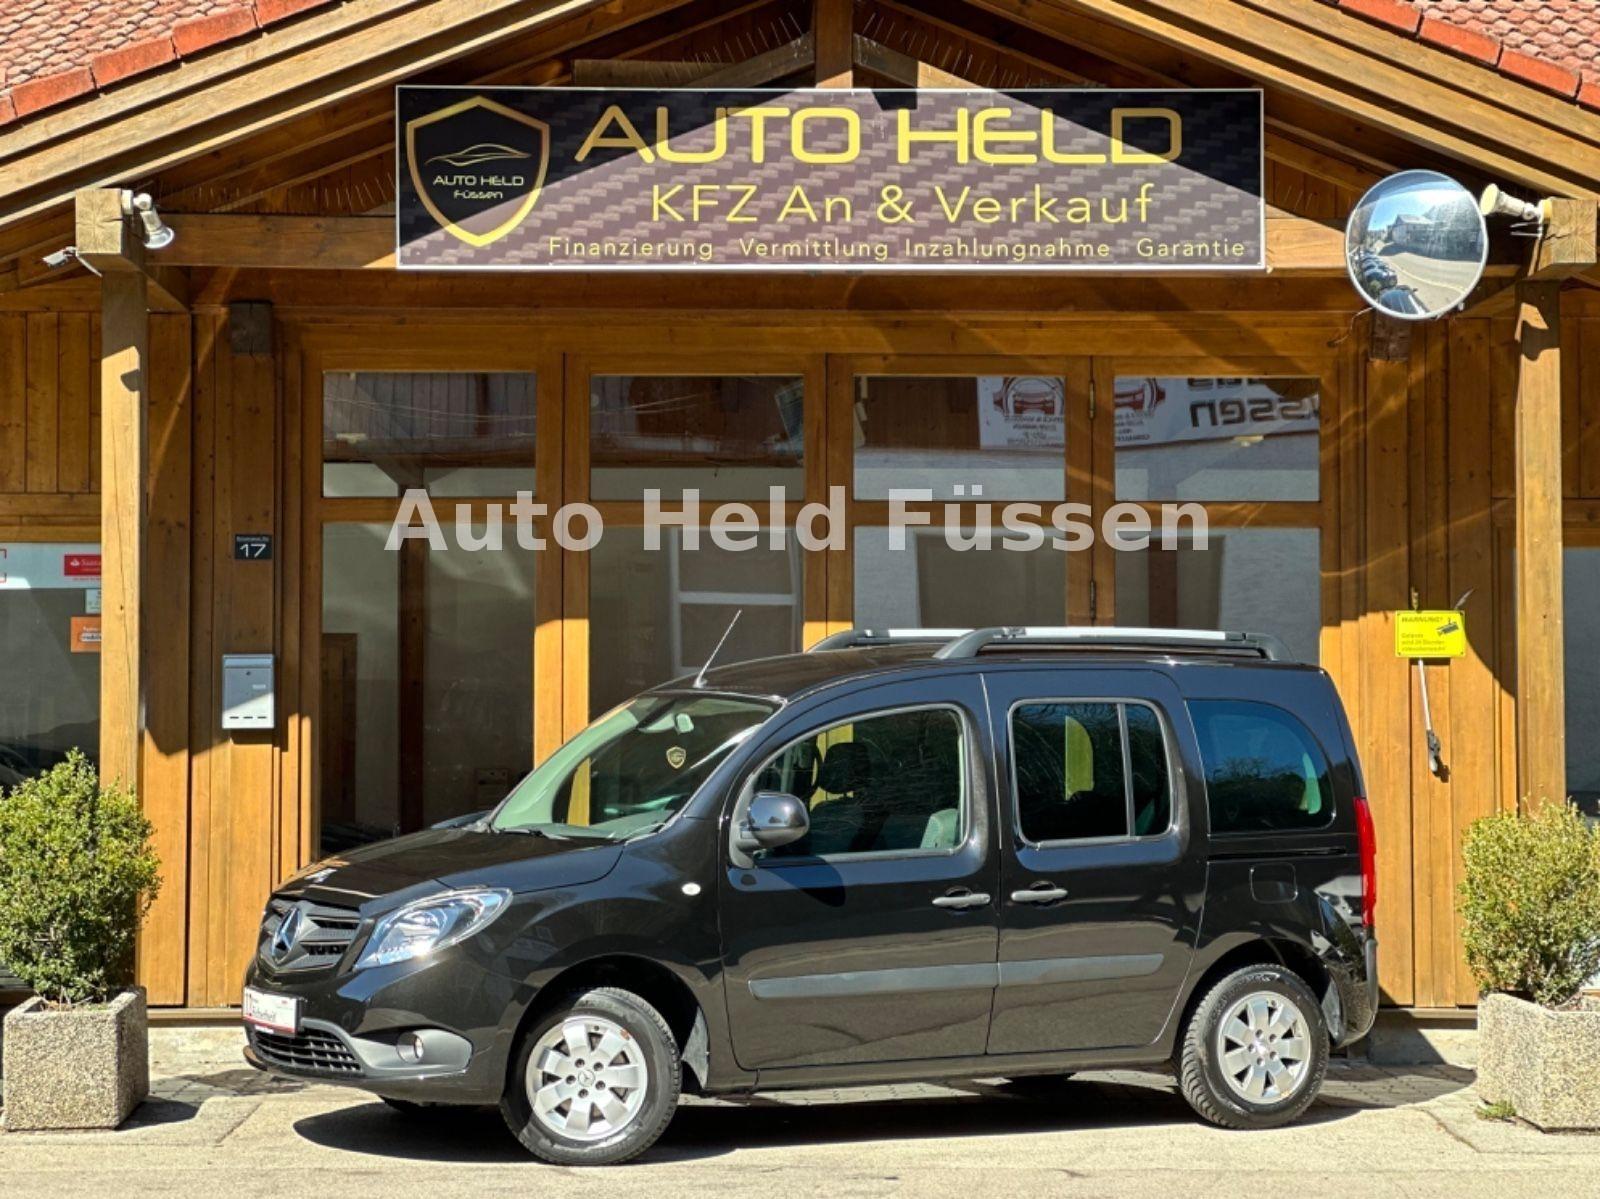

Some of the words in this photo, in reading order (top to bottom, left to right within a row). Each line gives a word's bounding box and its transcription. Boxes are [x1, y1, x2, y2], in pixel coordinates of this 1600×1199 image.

[574, 105, 862, 165] AUTO
[896, 106, 1182, 165] HELD
[432, 175, 477, 186] AUTO
[480, 175, 525, 186] HELD
[652, 184, 758, 223] KFZ
[778, 184, 852, 222] An
[877, 184, 915, 223] &
[935, 182, 1155, 224] Verkauf
[549, 236, 713, 262] Finanzierung
[739, 237, 888, 262] Vermittlung
[905, 237, 1110, 262] Inzahlungnahme
[1137, 237, 1246, 258] Garantie
[239, 543, 267, 558] 17
